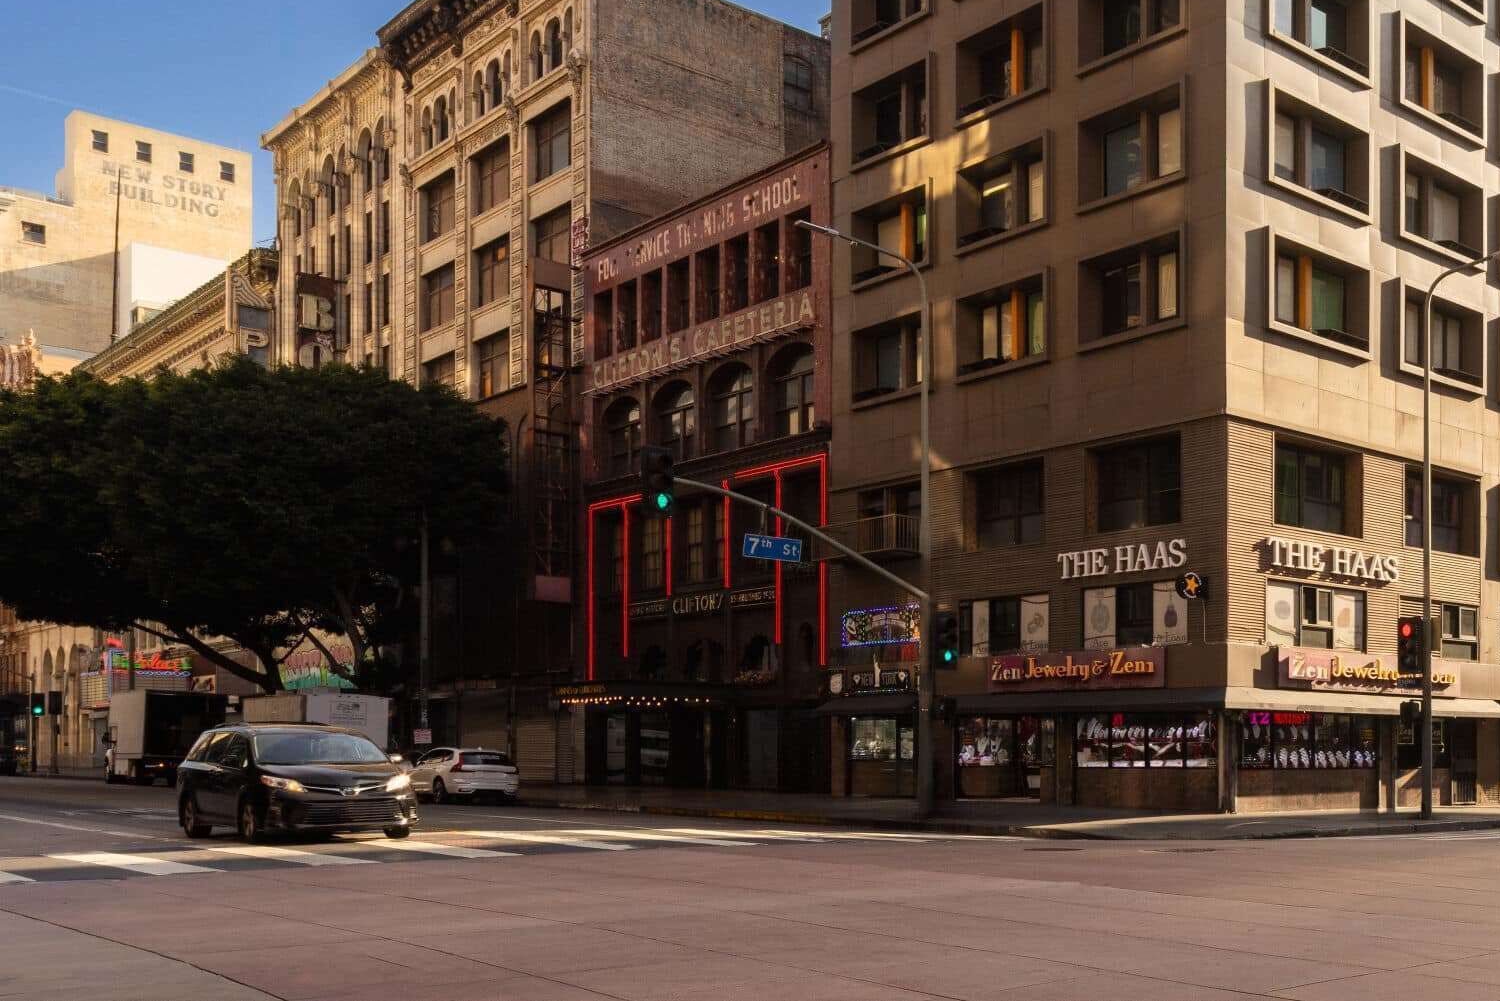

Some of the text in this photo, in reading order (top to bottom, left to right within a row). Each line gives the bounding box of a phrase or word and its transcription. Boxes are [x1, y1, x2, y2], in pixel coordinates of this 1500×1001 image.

[102, 160, 226, 201] NEW STORY
[109, 181, 219, 218] BUILDING
[593, 292, 815, 389] CLIFTON'S CAFETERIA
[748, 537, 773, 555] 7th
[1057, 538, 1187, 579] THE HAAS
[1267, 536, 1400, 582] THE HAAS
[1025, 656, 1090, 681] Jewelry
[1291, 655, 1329, 678] Zen
